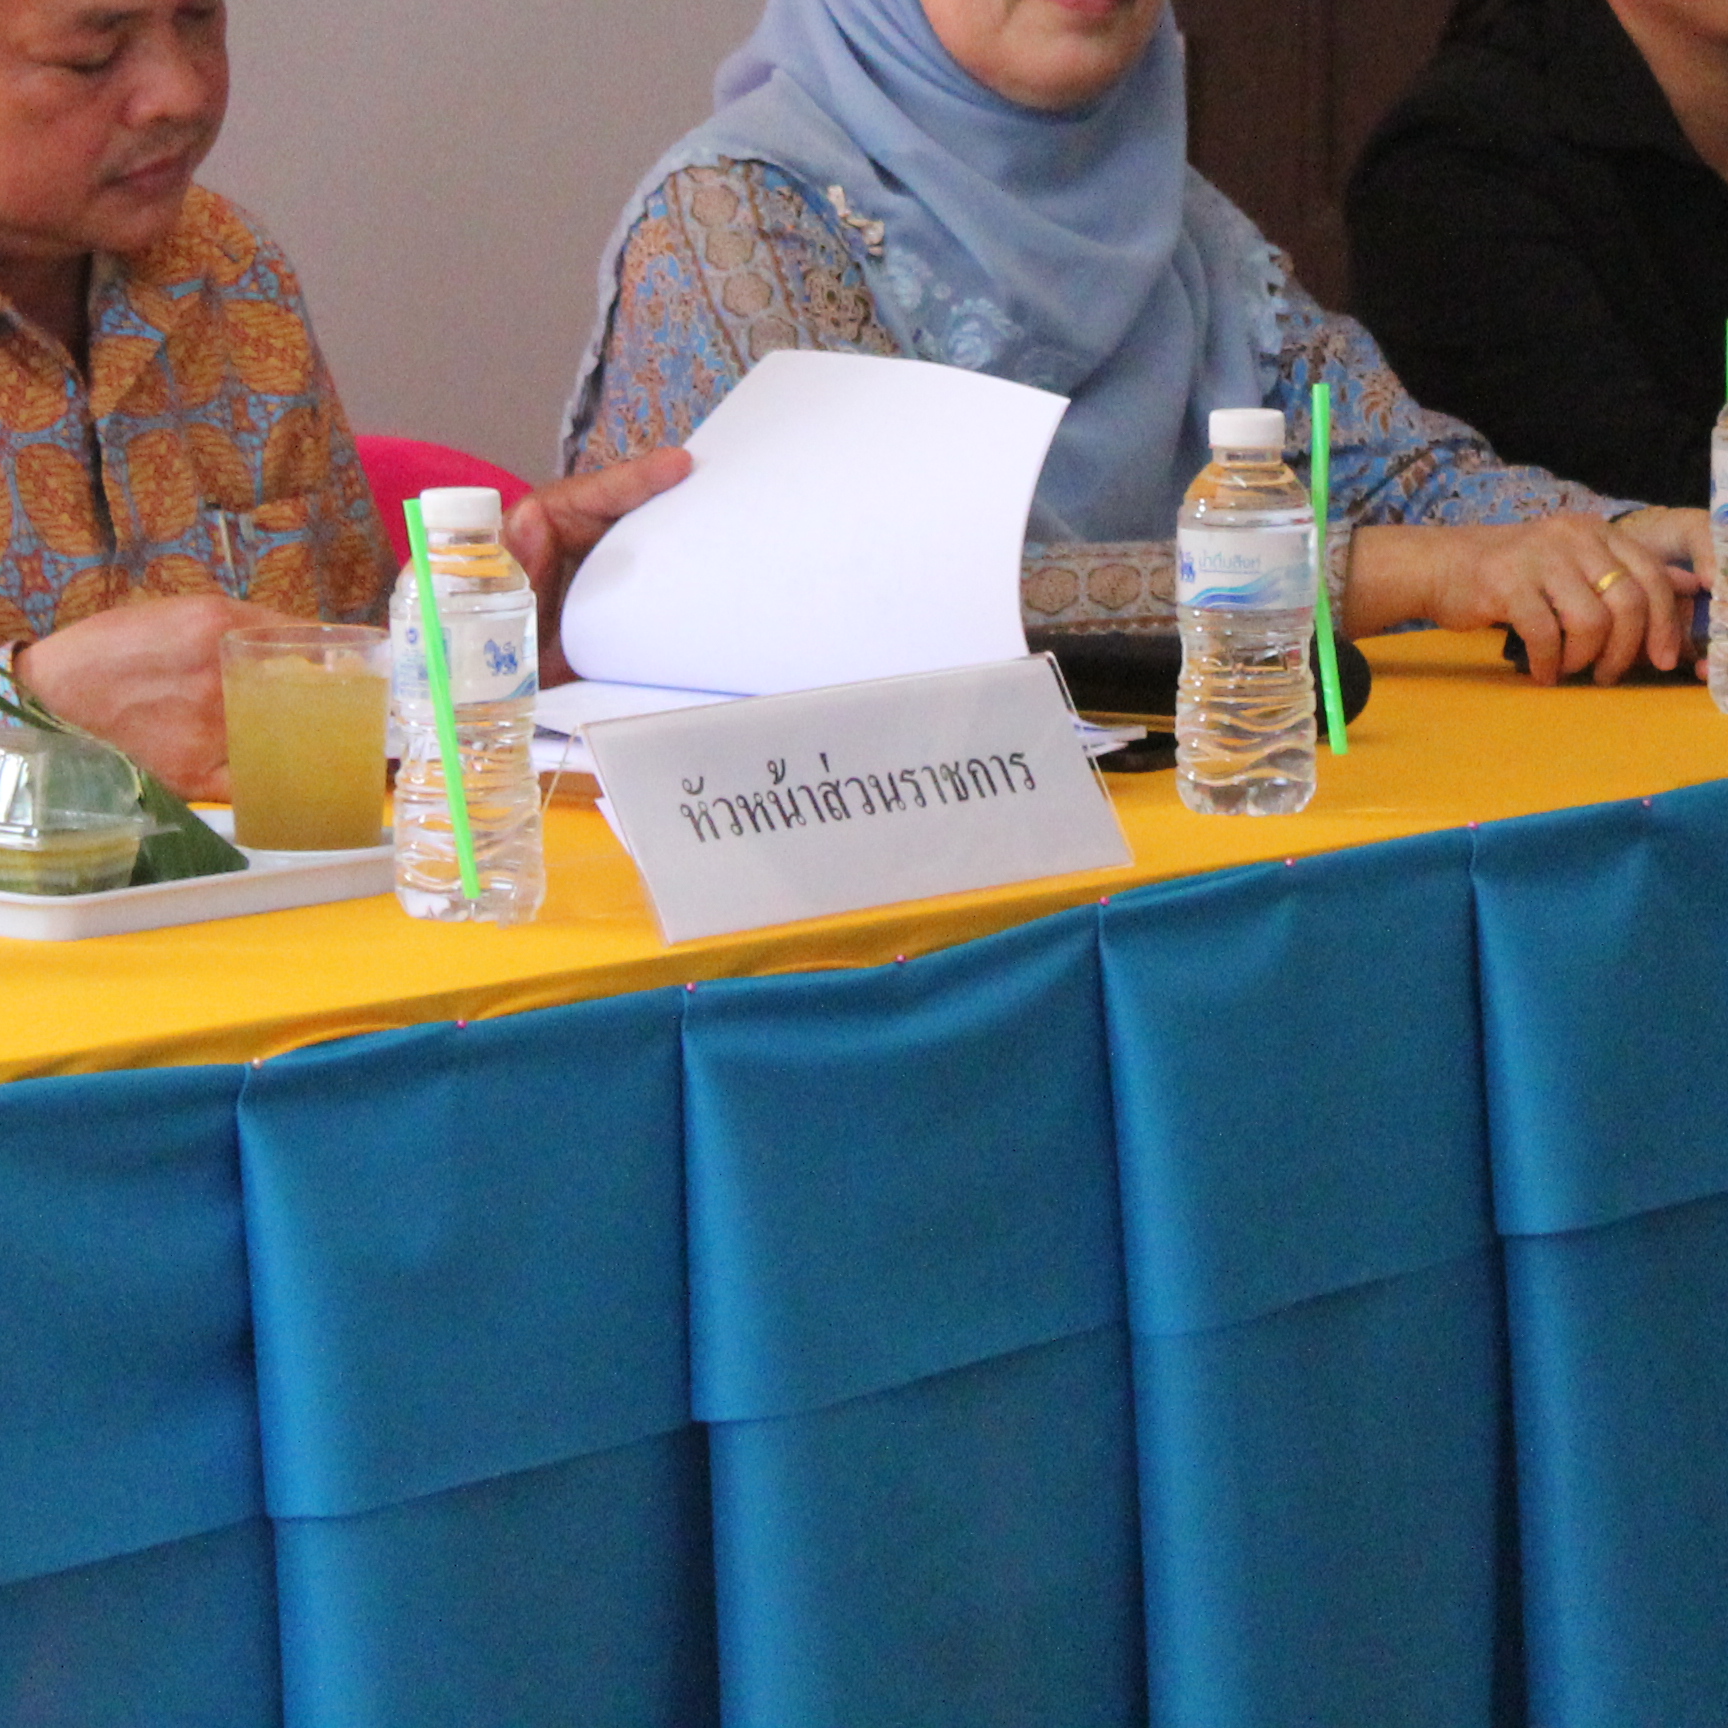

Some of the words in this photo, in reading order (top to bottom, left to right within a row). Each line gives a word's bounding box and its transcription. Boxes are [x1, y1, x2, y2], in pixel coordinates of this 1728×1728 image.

[679, 751, 1039, 844] หัวหน้าส่วนราชการ
